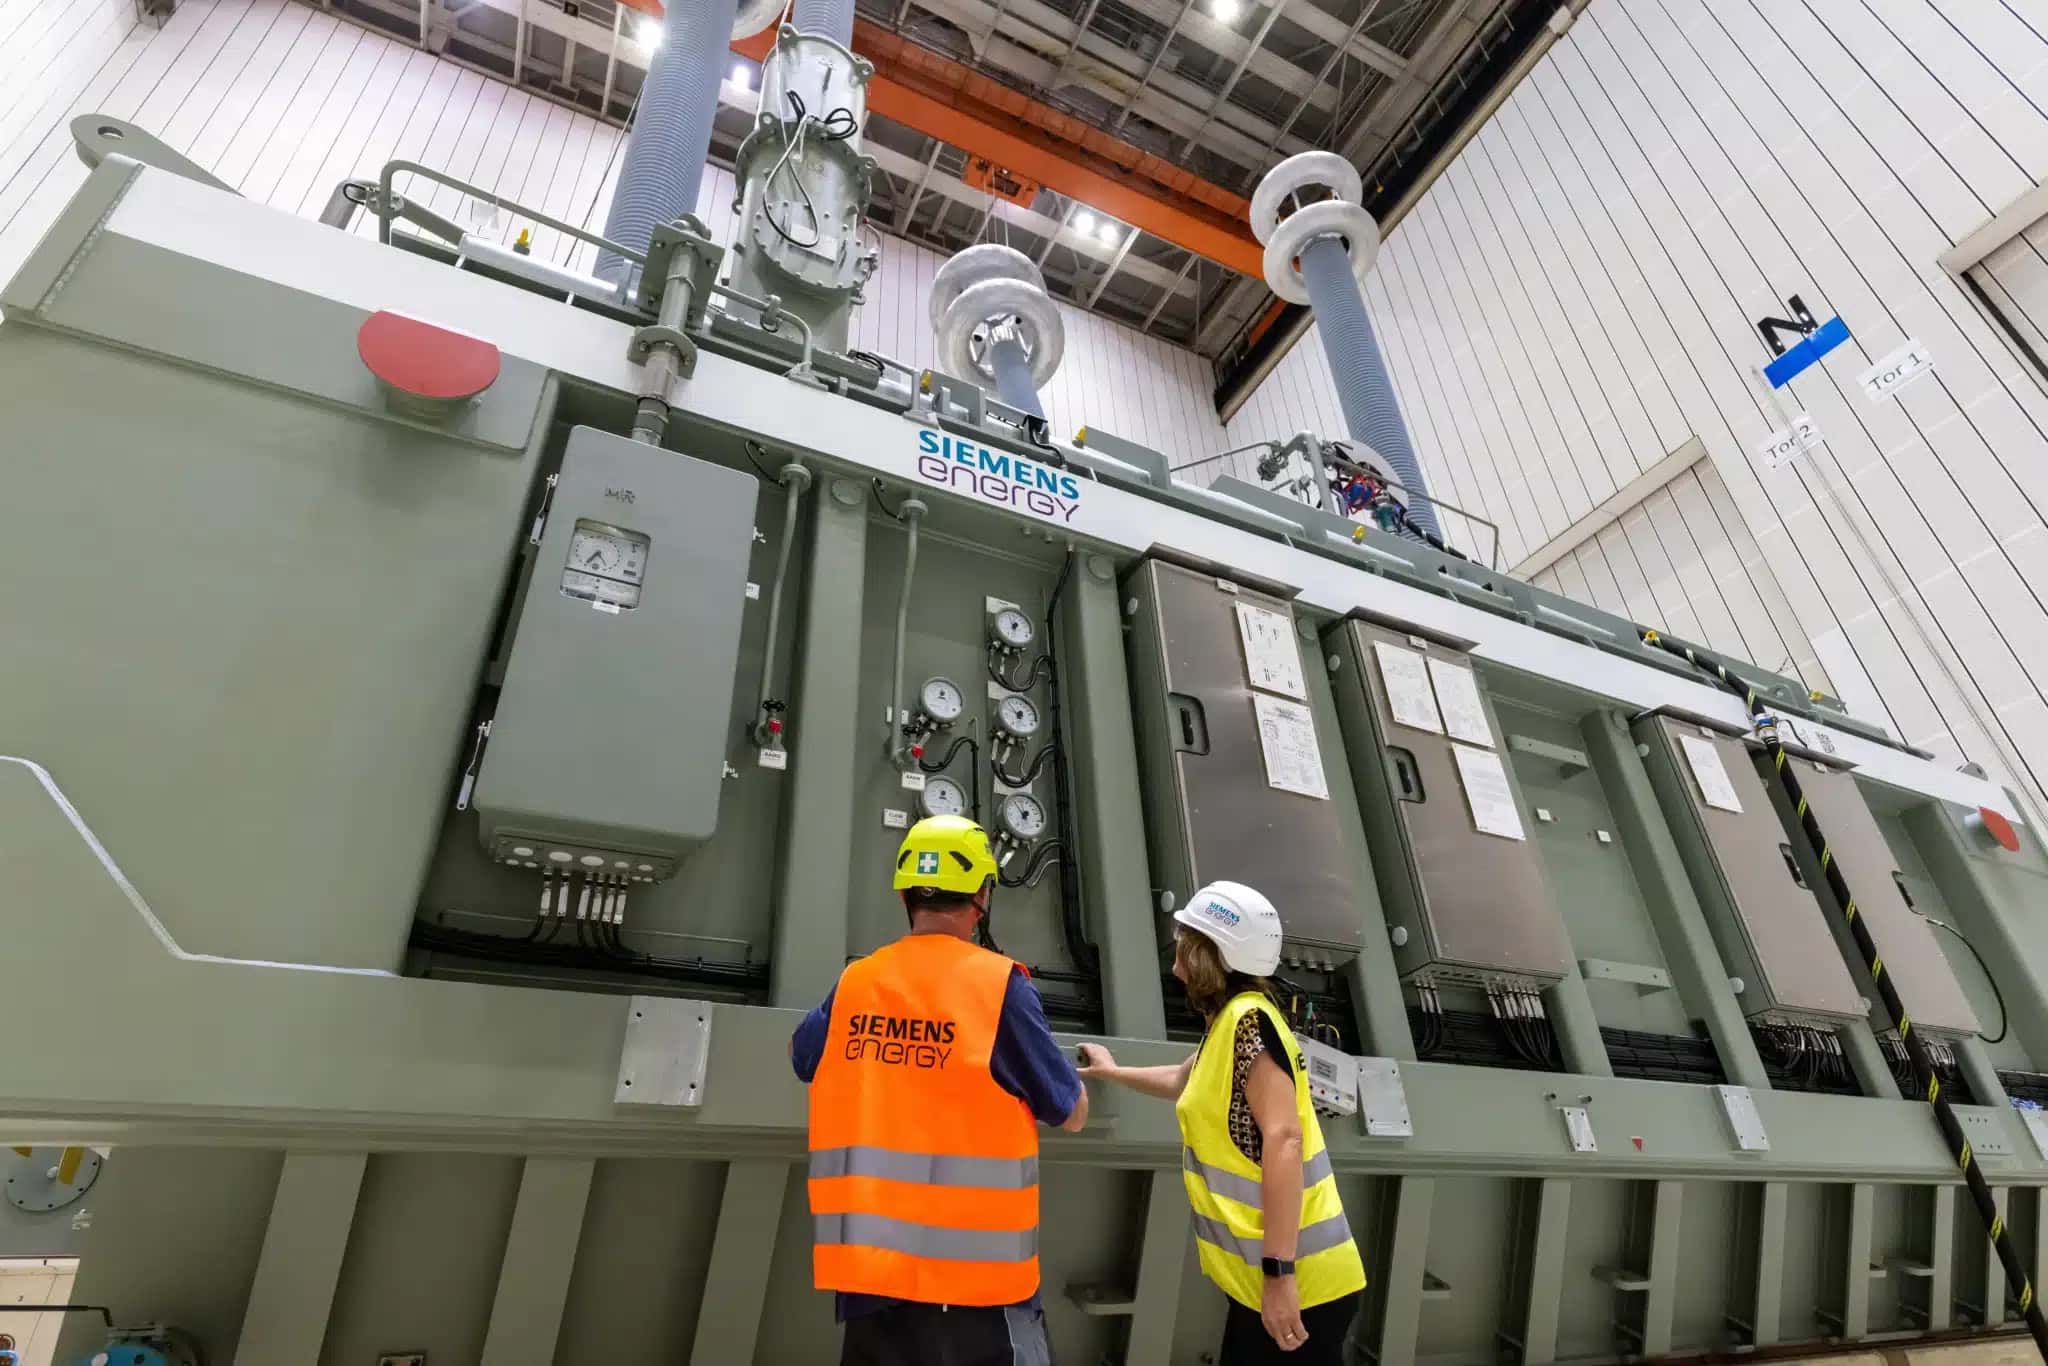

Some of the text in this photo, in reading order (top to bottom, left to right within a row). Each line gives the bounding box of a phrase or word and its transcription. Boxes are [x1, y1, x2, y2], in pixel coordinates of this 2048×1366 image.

[1868, 352, 1922, 390] Tor 1
[1766, 424, 1813, 459] Tor 2
[919, 430, 1080, 500] SIEMENS
[1208, 901, 1240, 922] SIEMENS
[848, 1014, 955, 1043] SIEMENS
